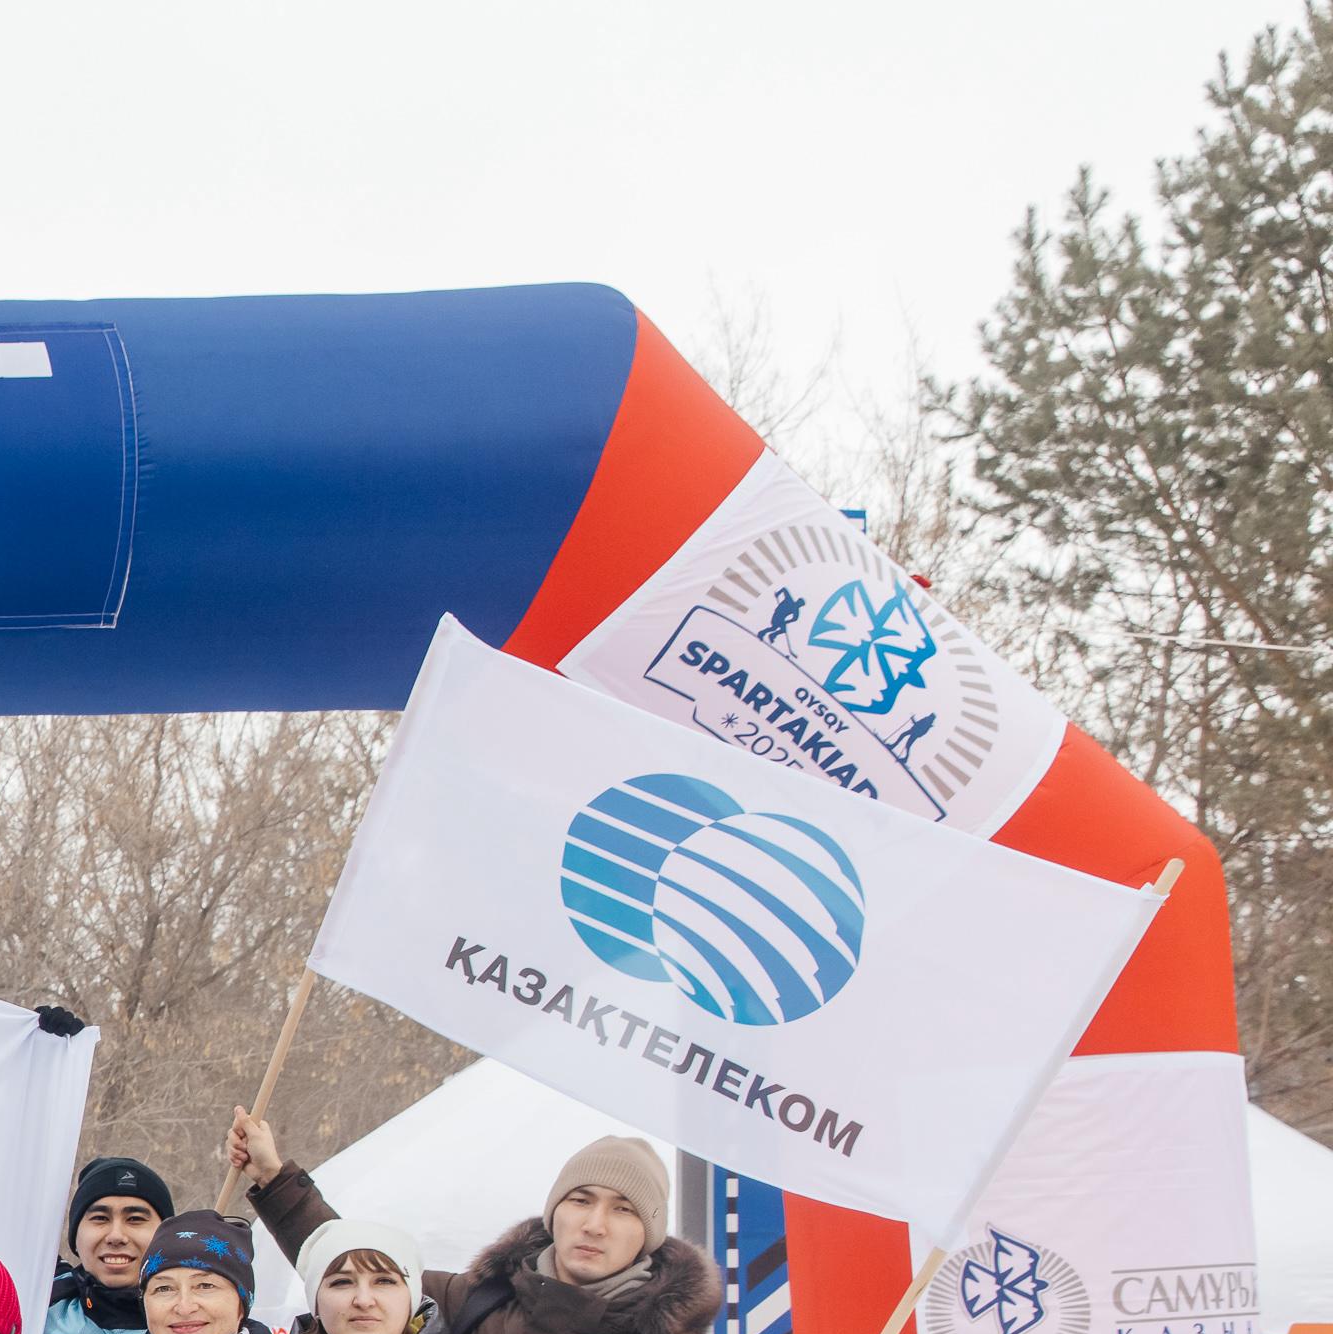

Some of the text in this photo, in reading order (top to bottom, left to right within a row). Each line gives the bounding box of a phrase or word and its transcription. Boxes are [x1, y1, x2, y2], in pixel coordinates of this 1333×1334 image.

[678, 640, 879, 801] SPARTAKIAD
[793, 686, 851, 735] QYSQY
[444, 935, 865, 1158] ҚАЗАҚТЕЛЕКОМ
